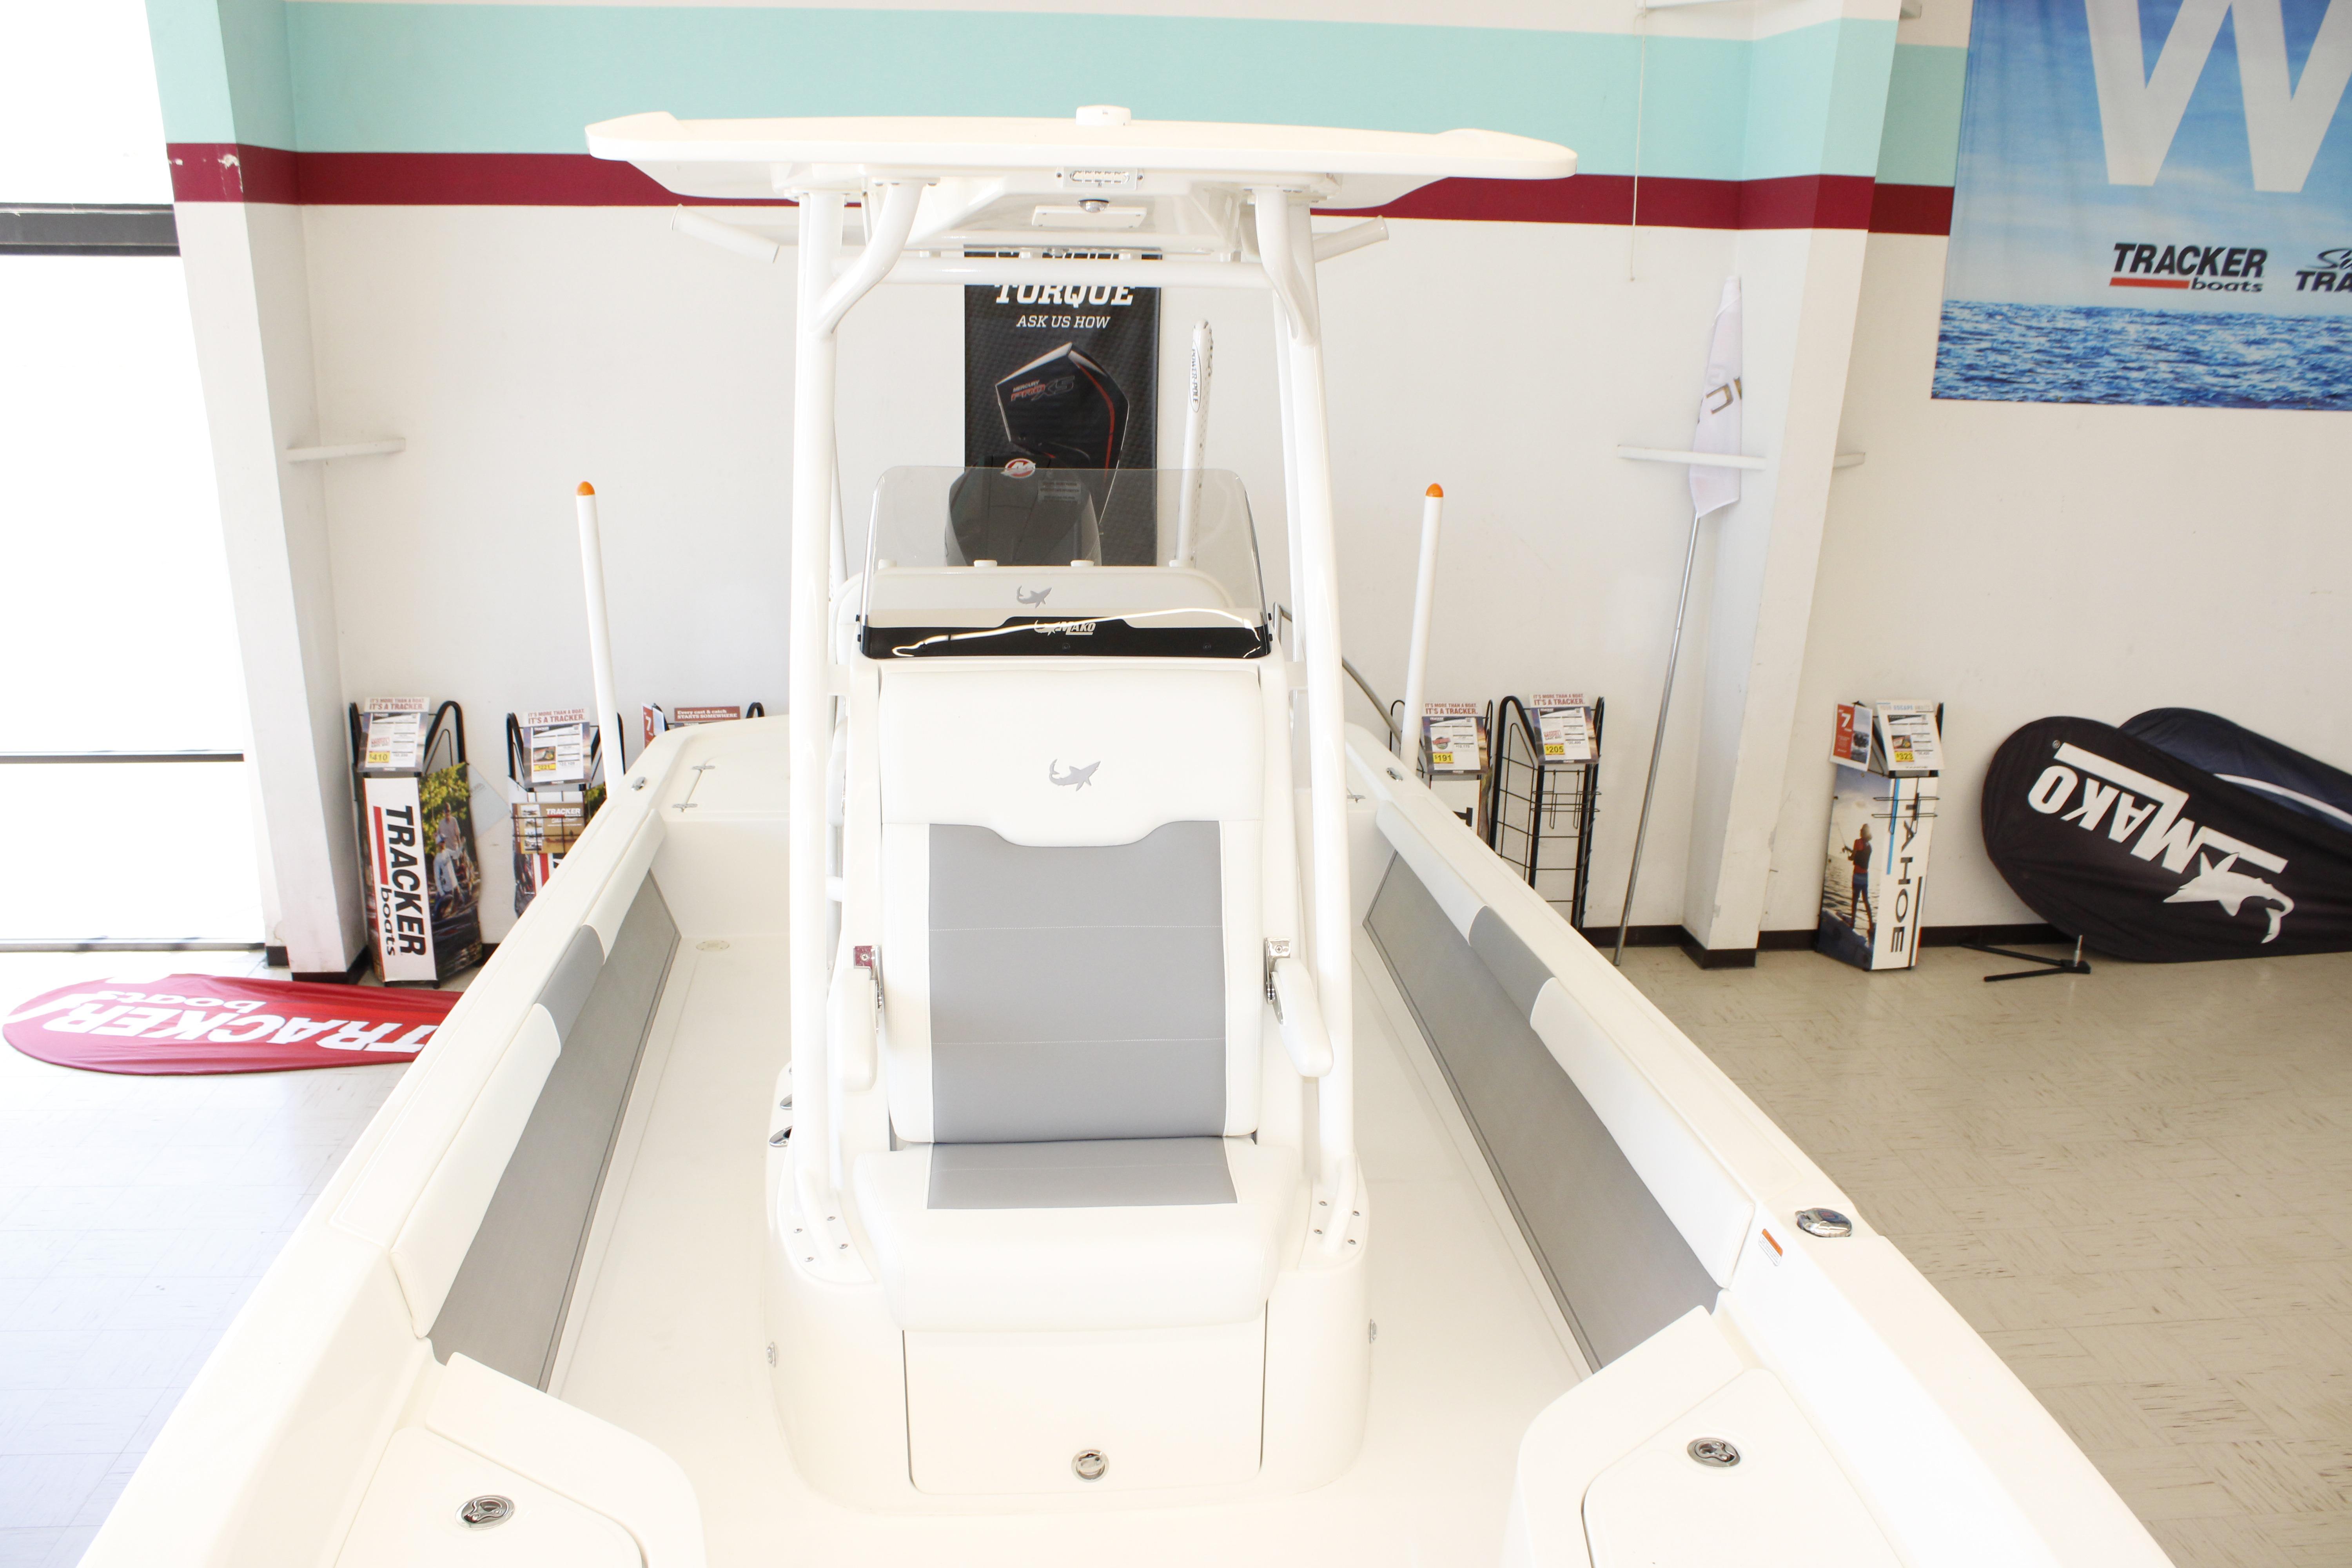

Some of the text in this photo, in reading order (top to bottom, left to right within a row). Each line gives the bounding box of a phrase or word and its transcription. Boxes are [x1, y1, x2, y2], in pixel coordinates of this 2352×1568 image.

[2113, 243, 2268, 278] TRACKER
[2191, 278, 2263, 292] boats
[995, 285, 1135, 308] TORQUE
[1016, 315, 1111, 329] ASK US HOW
[1013, 379, 1040, 392] MERCURY
[1055, 621, 1096, 635] MAKO
[645, 716, 652, 731] 7
[1842, 713, 1851, 727] 7
[2028, 742, 2288, 873] MAKO
[386, 806, 426, 955] TRACKER
[1891, 793, 1920, 953] TAHOE
[381, 887, 396, 956] boats
[97, 991, 267, 1013] boats
[42, 1003, 439, 1053] TRACKER
